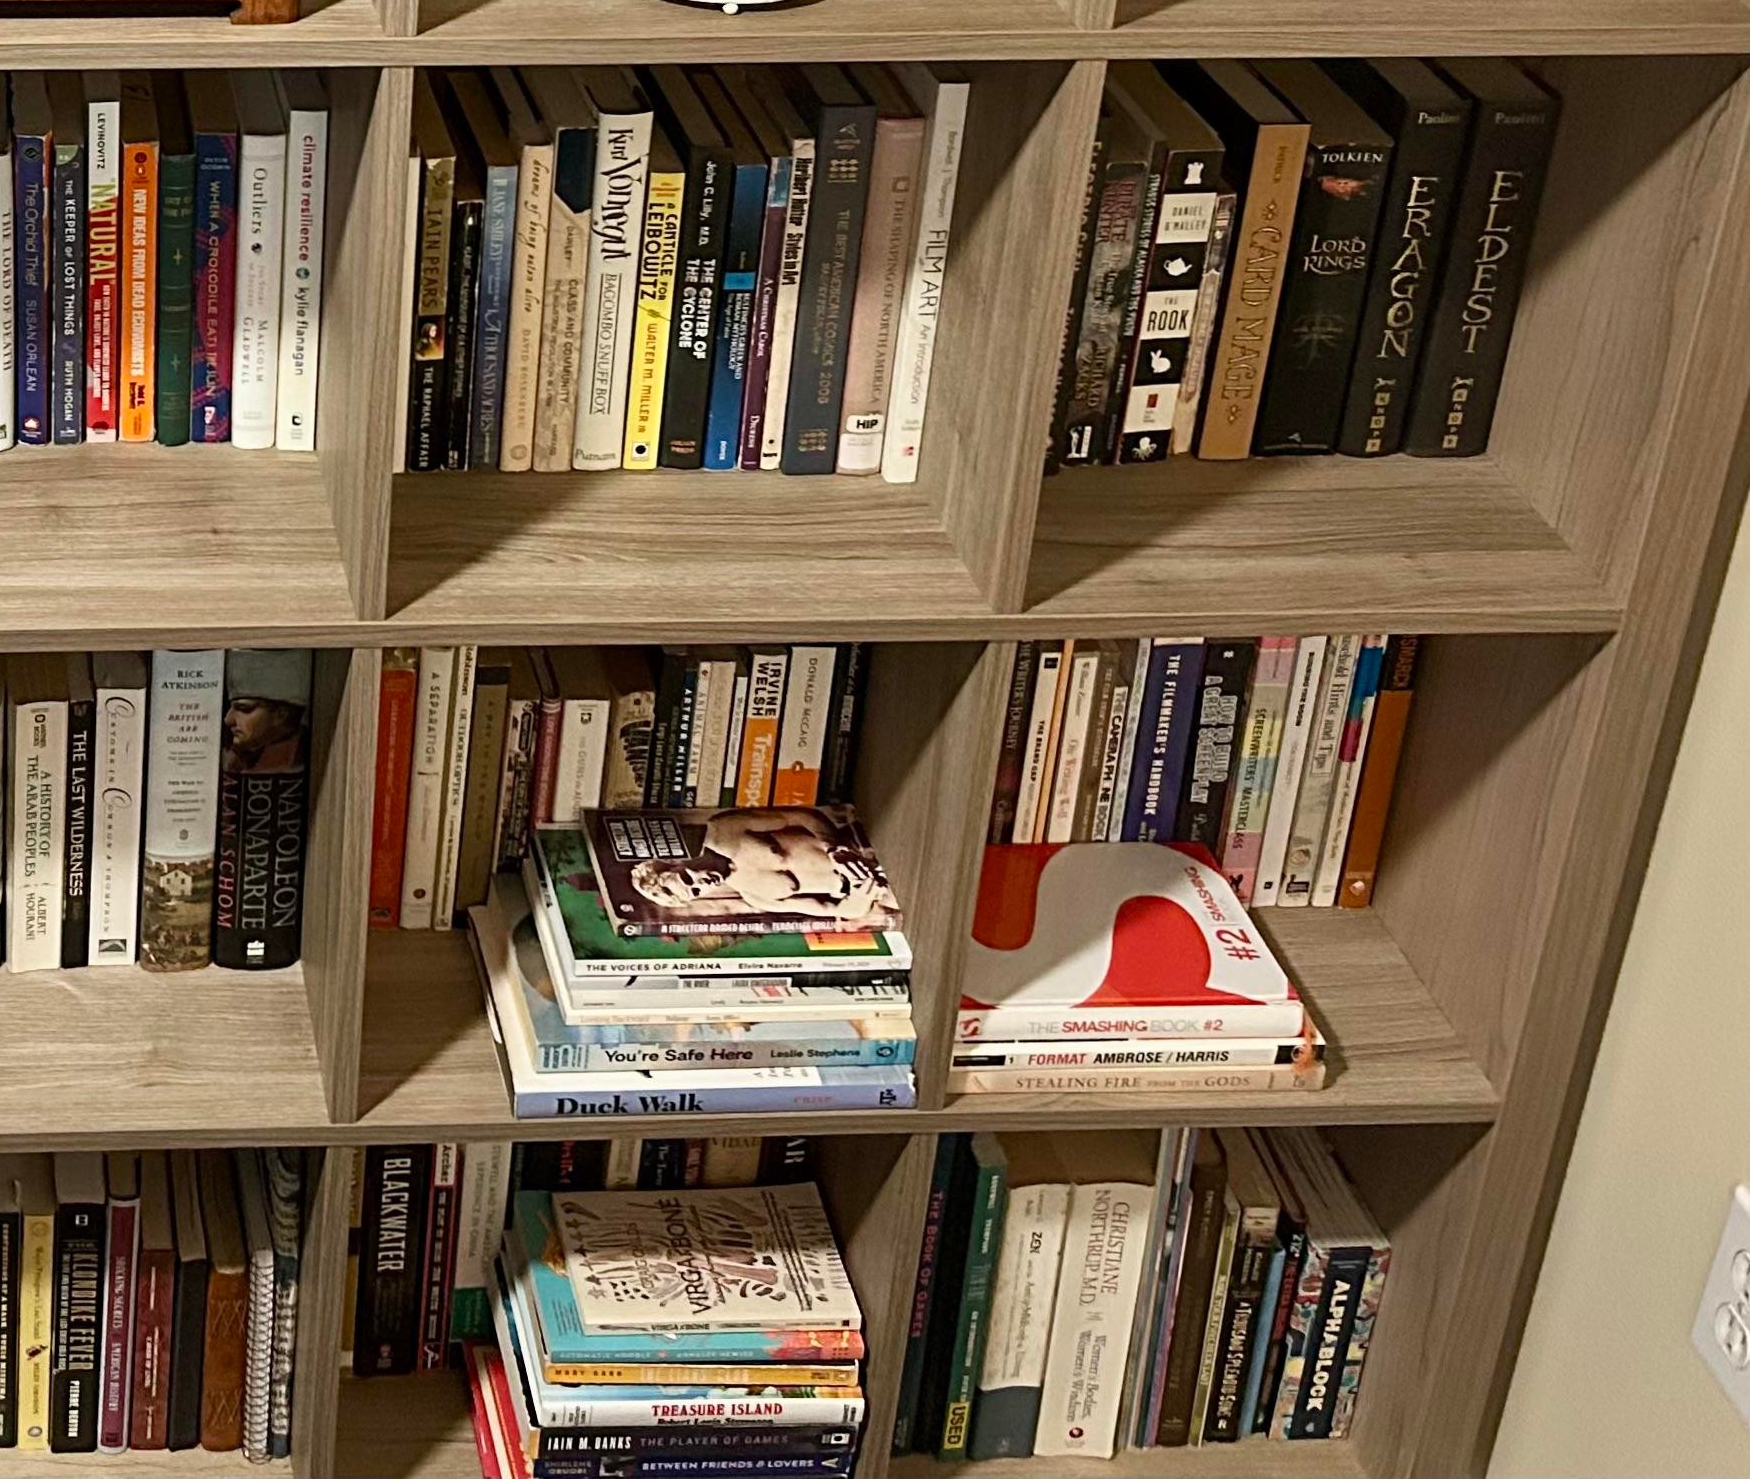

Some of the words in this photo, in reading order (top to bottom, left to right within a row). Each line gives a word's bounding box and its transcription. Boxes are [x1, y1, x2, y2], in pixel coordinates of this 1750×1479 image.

[1323, 151, 1384, 163] TOLKIEN
[923, 230, 947, 277] FILM
[1378, 176, 1438, 359] ERAGON
[1462, 171, 1522, 353] ELDEST
[917, 279, 937, 319] ART
[1148, 310, 1188, 330] ROOK
[856, 419, 877, 428] HIP
[752, 662, 769, 717] WELSH
[766, 662, 781, 717] IRVINE
[68, 805, 85, 897] WILDERNESS
[1215, 928, 1258, 960] #2
[1062, 1020, 1147, 1032] SMASHING
[1204, 1020, 1223, 1031] #2
[605, 1048, 659, 1064] You're
[664, 1049, 705, 1062] Safe
[710, 1048, 753, 1061] Here
[1028, 1053, 1085, 1065] FORMAT
[1093, 1052, 1163, 1063] AMBROSE
[1176, 1051, 1229, 1061] HARRIS
[556, 1095, 629, 1115] Duck
[640, 1094, 703, 1113] Walk
[378, 1159, 411, 1272] BLACKWATER
[1306, 1279, 1351, 1412] ALPHABLOCK
[652, 1403, 726, 1416] TREASURE
[731, 1401, 783, 1415] ISLAND
[946, 1403, 966, 1446] USED
